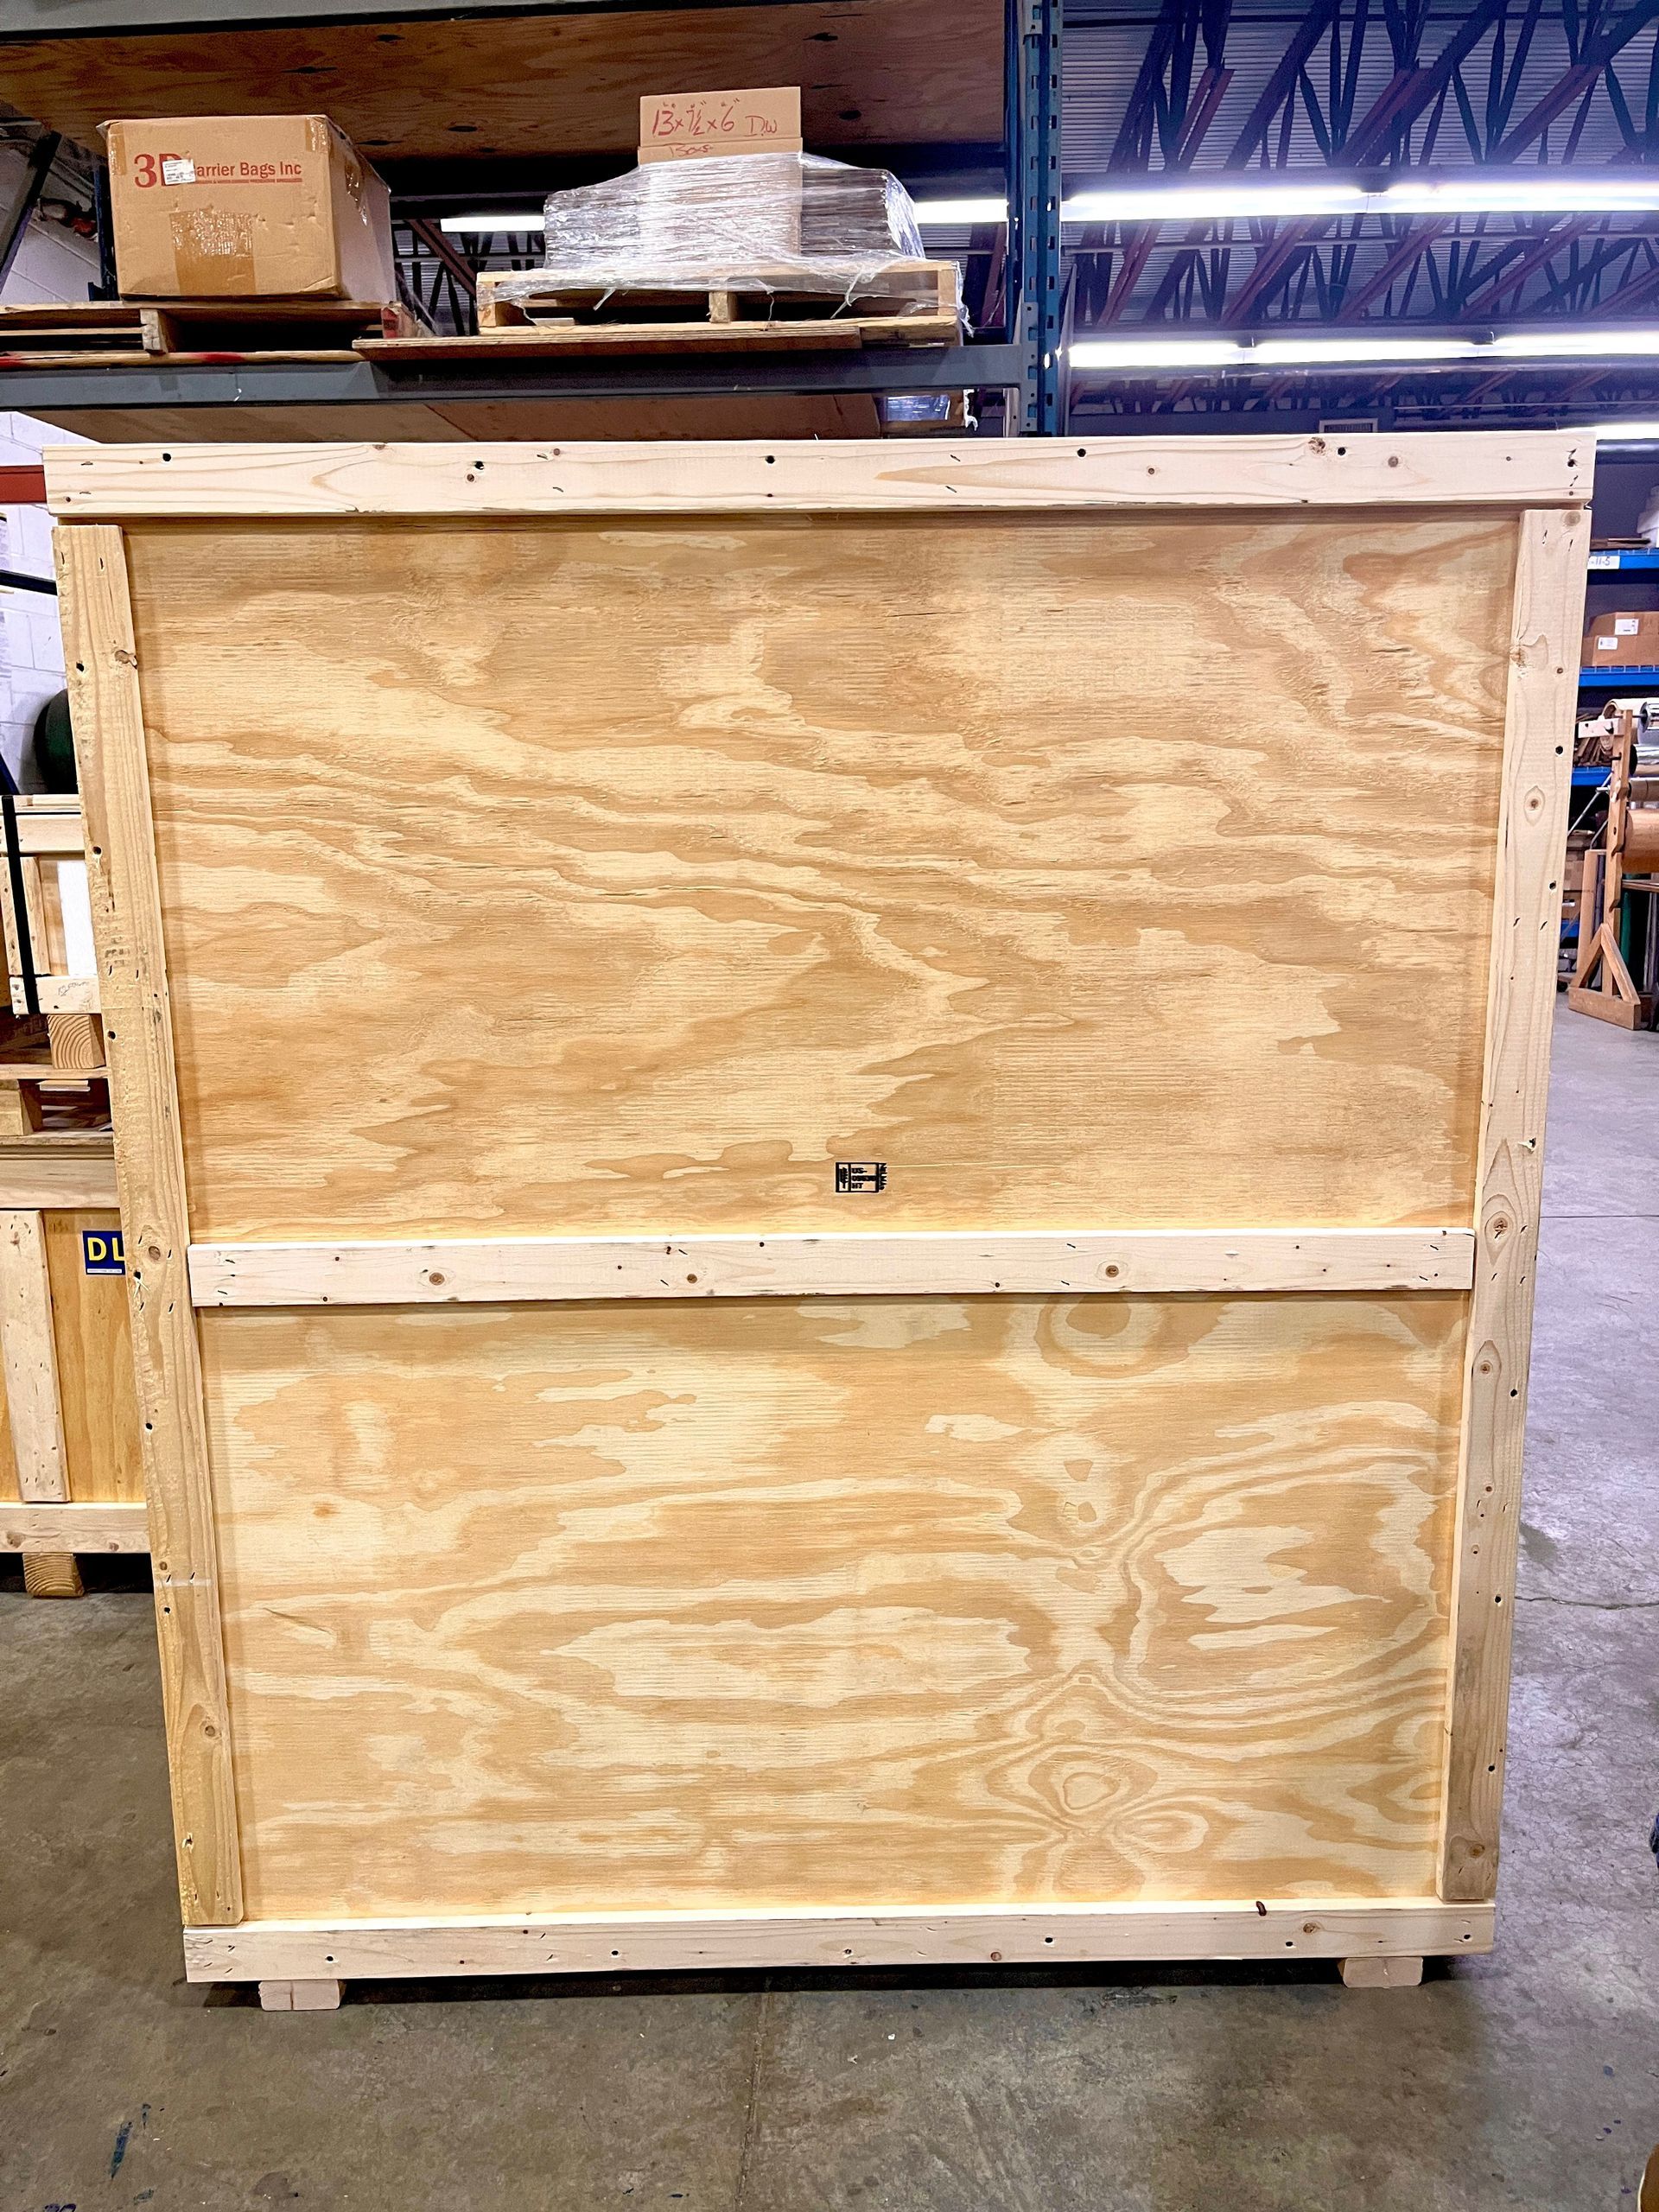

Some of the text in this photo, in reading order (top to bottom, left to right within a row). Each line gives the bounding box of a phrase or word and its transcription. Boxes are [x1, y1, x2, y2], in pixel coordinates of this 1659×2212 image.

[194, 162, 235, 177] arrier
[240, 162, 276, 178] Bags
[279, 161, 302, 175] Inc
